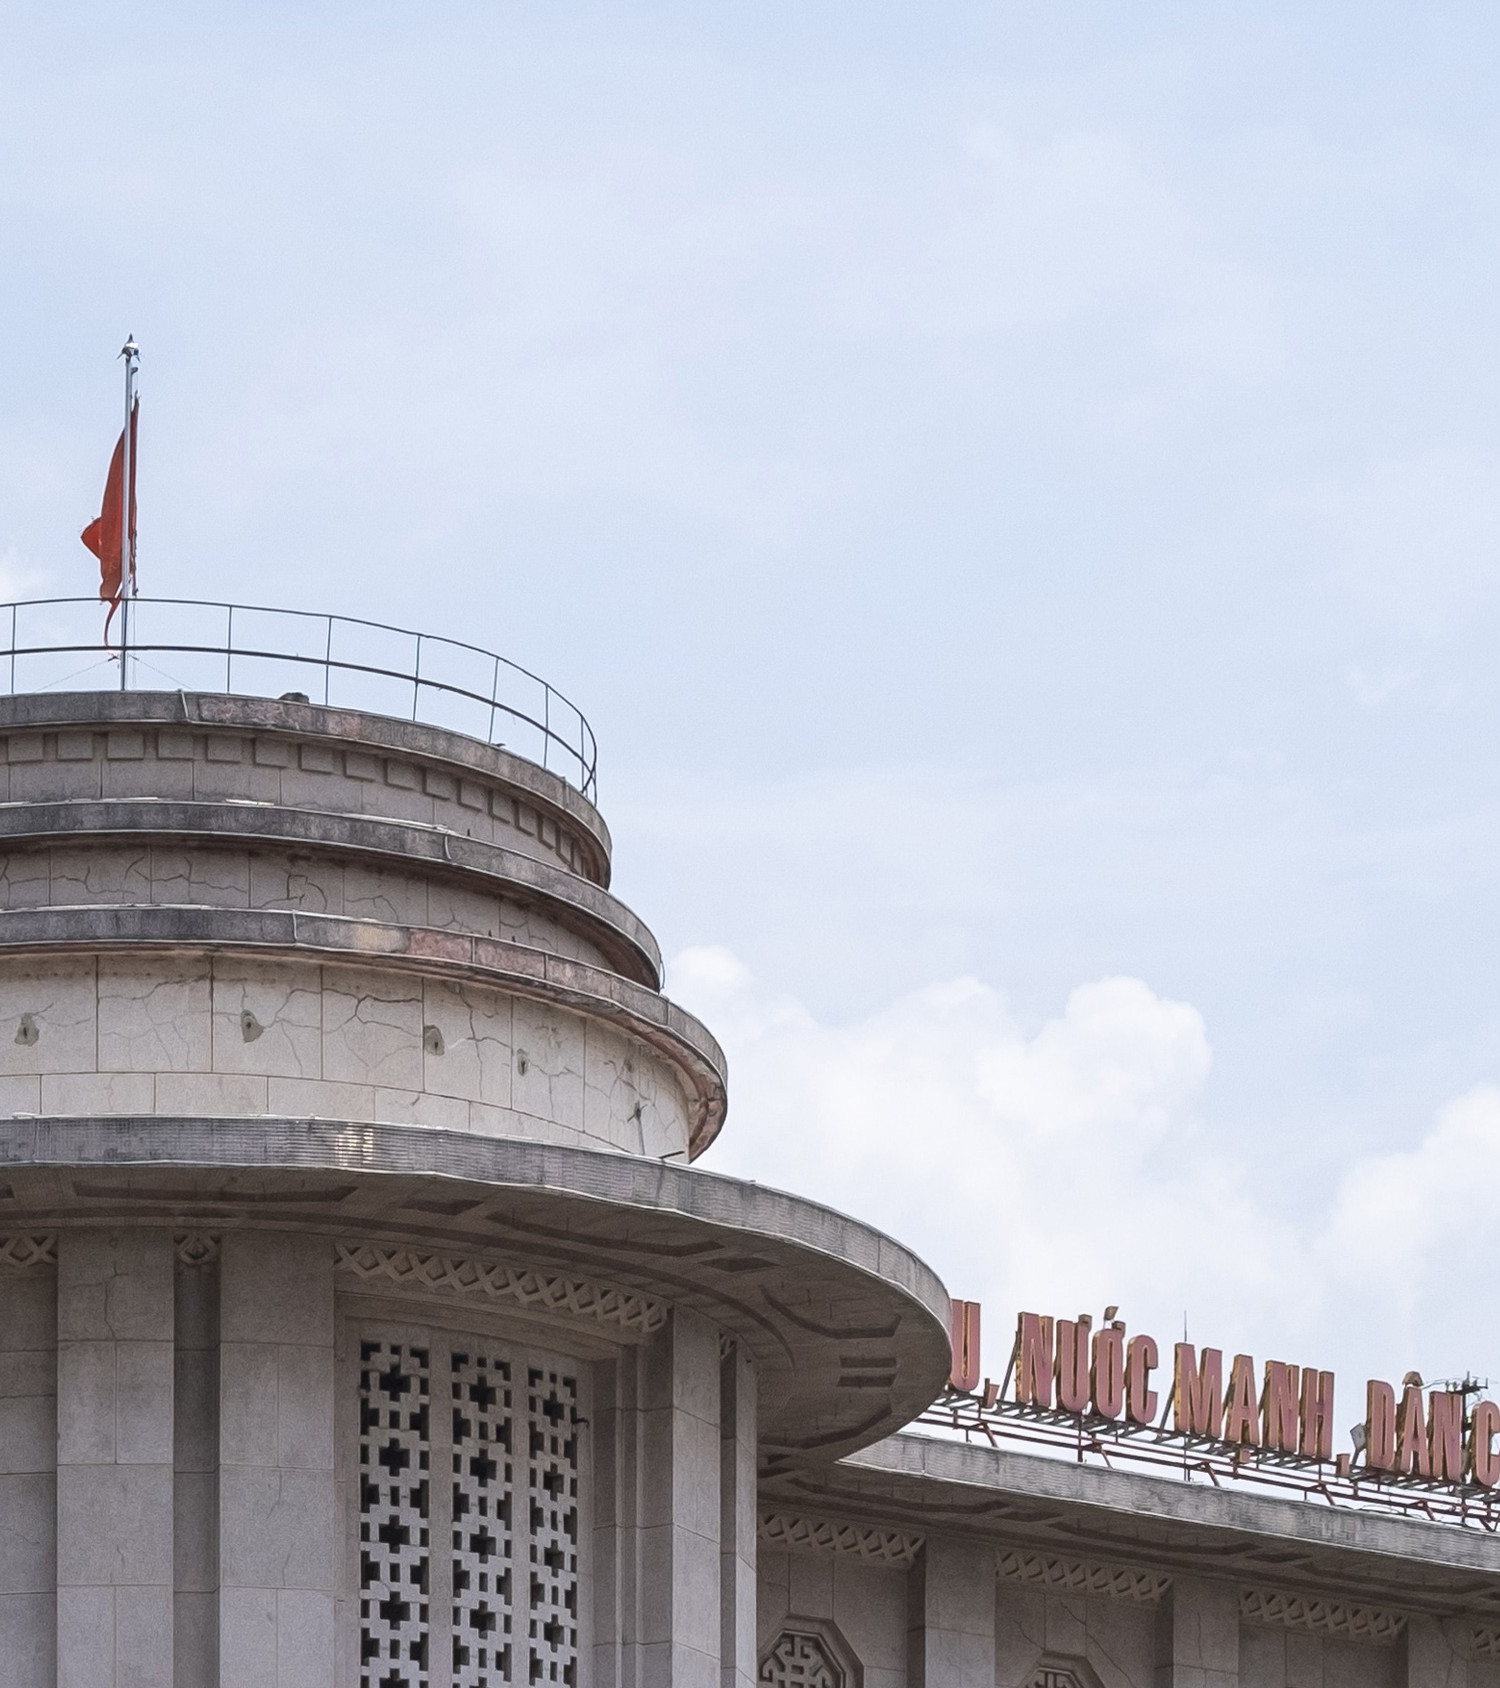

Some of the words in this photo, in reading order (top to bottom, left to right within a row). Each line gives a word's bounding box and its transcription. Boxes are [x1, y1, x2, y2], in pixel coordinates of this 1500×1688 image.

[1016, 1306, 1158, 1423] NƯỚC
[1174, 1343, 1349, 1477] MẠNH,
[1366, 1371, 1463, 1481] DÂN
